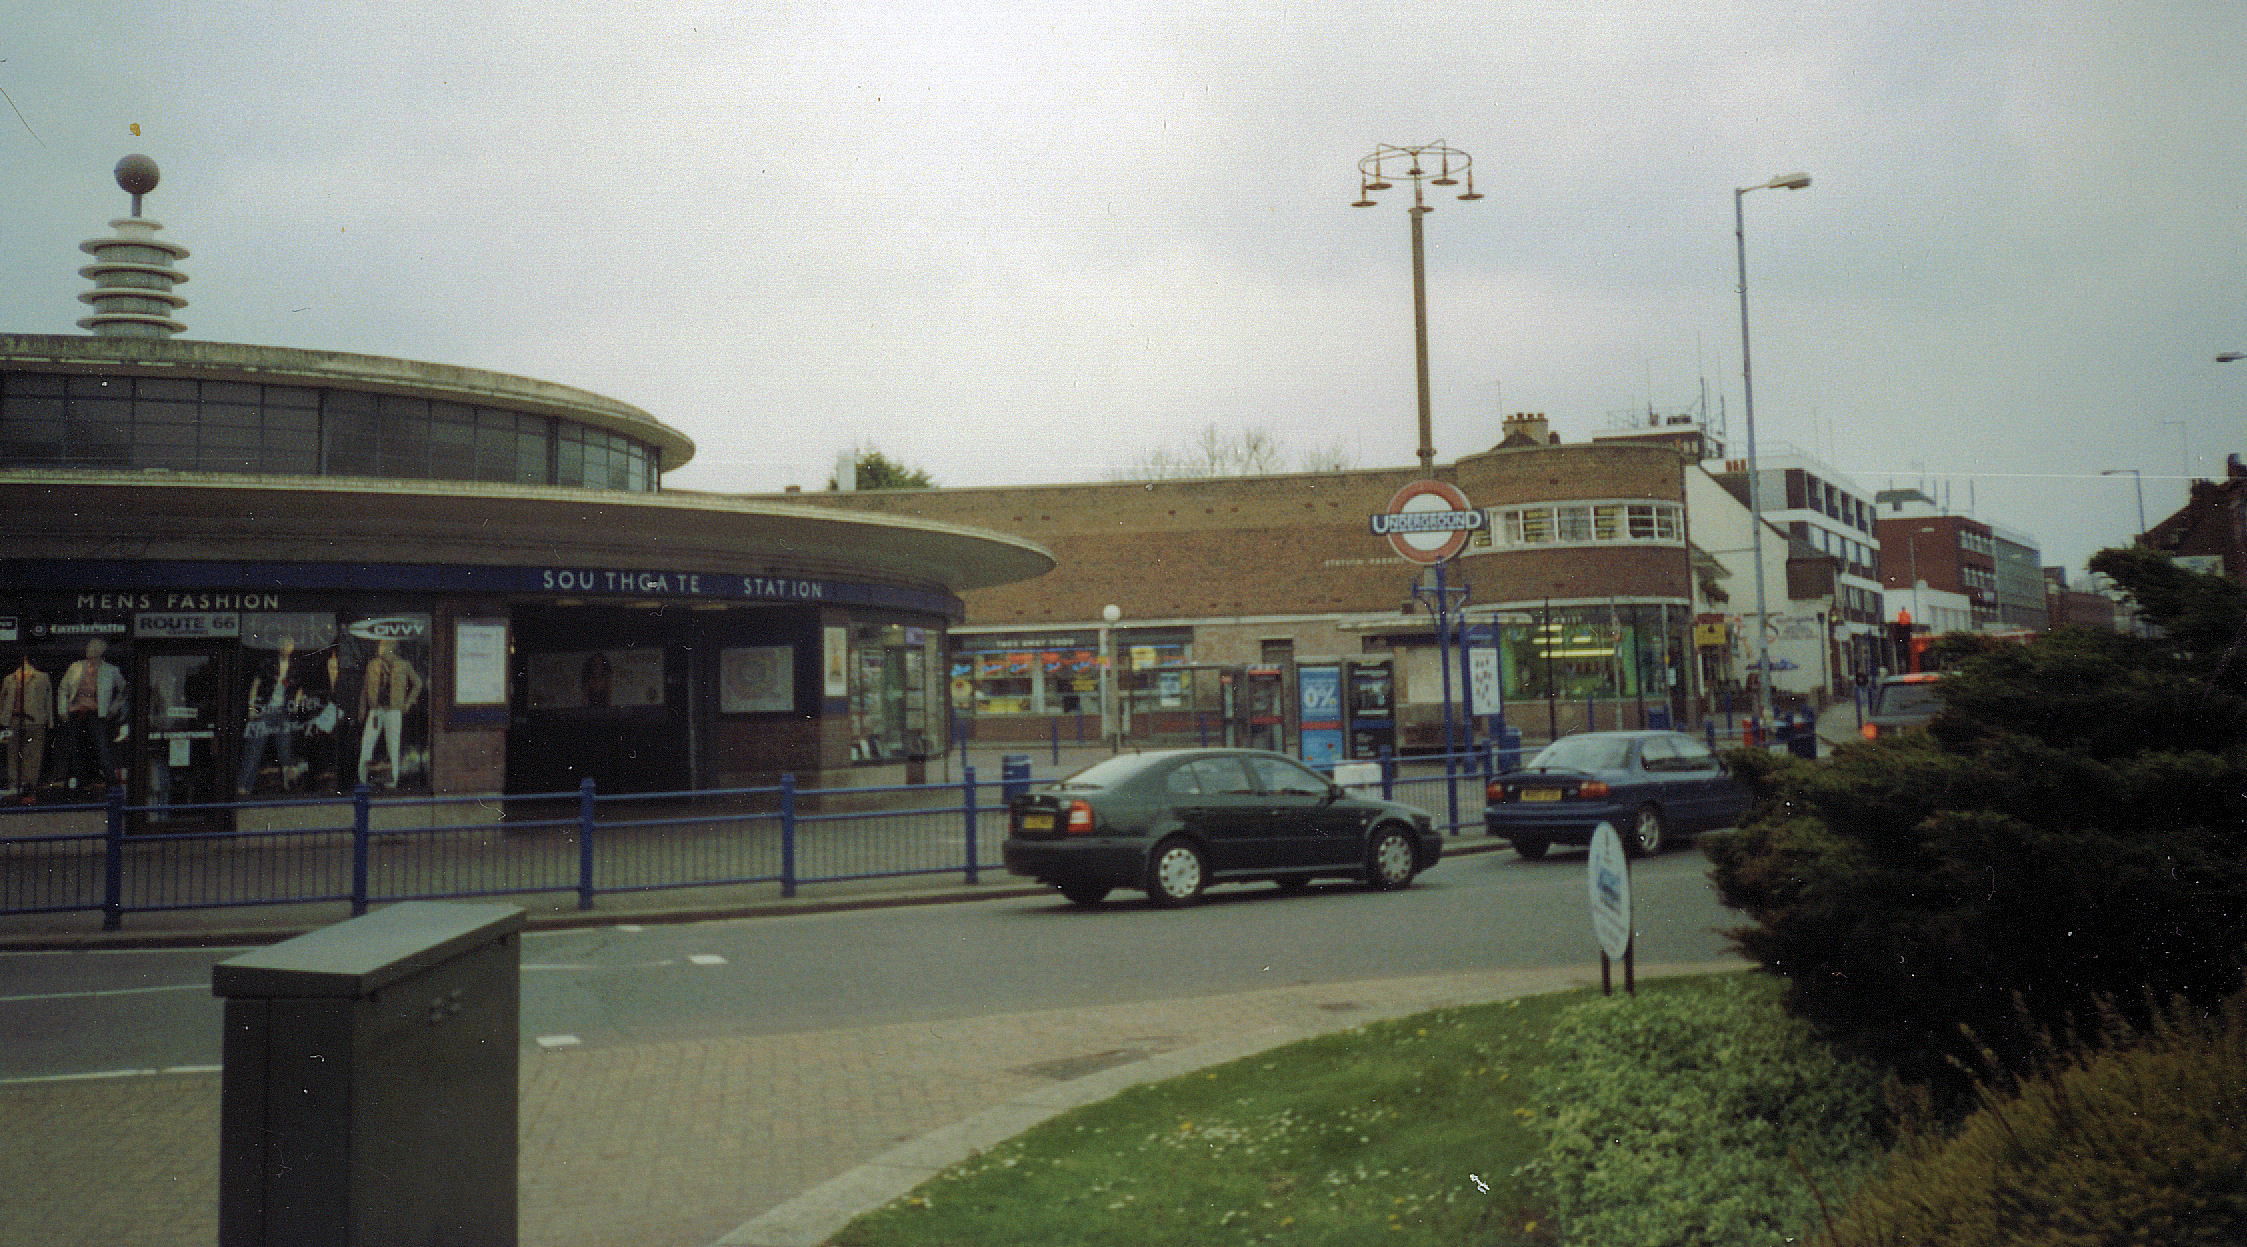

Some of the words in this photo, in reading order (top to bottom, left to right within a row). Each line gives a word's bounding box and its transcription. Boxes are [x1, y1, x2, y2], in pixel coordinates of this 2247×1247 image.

[1372, 511, 1482, 534] UNDERGROUND
[543, 570, 701, 594] SOUTHGATE
[744, 578, 822, 598] STATION
[77, 594, 151, 609] MENS
[167, 593, 280, 609] FASHION
[140, 616, 206, 630] ROUTE
[212, 616, 235, 629] 66
[1303, 685, 1337, 708] 0%
